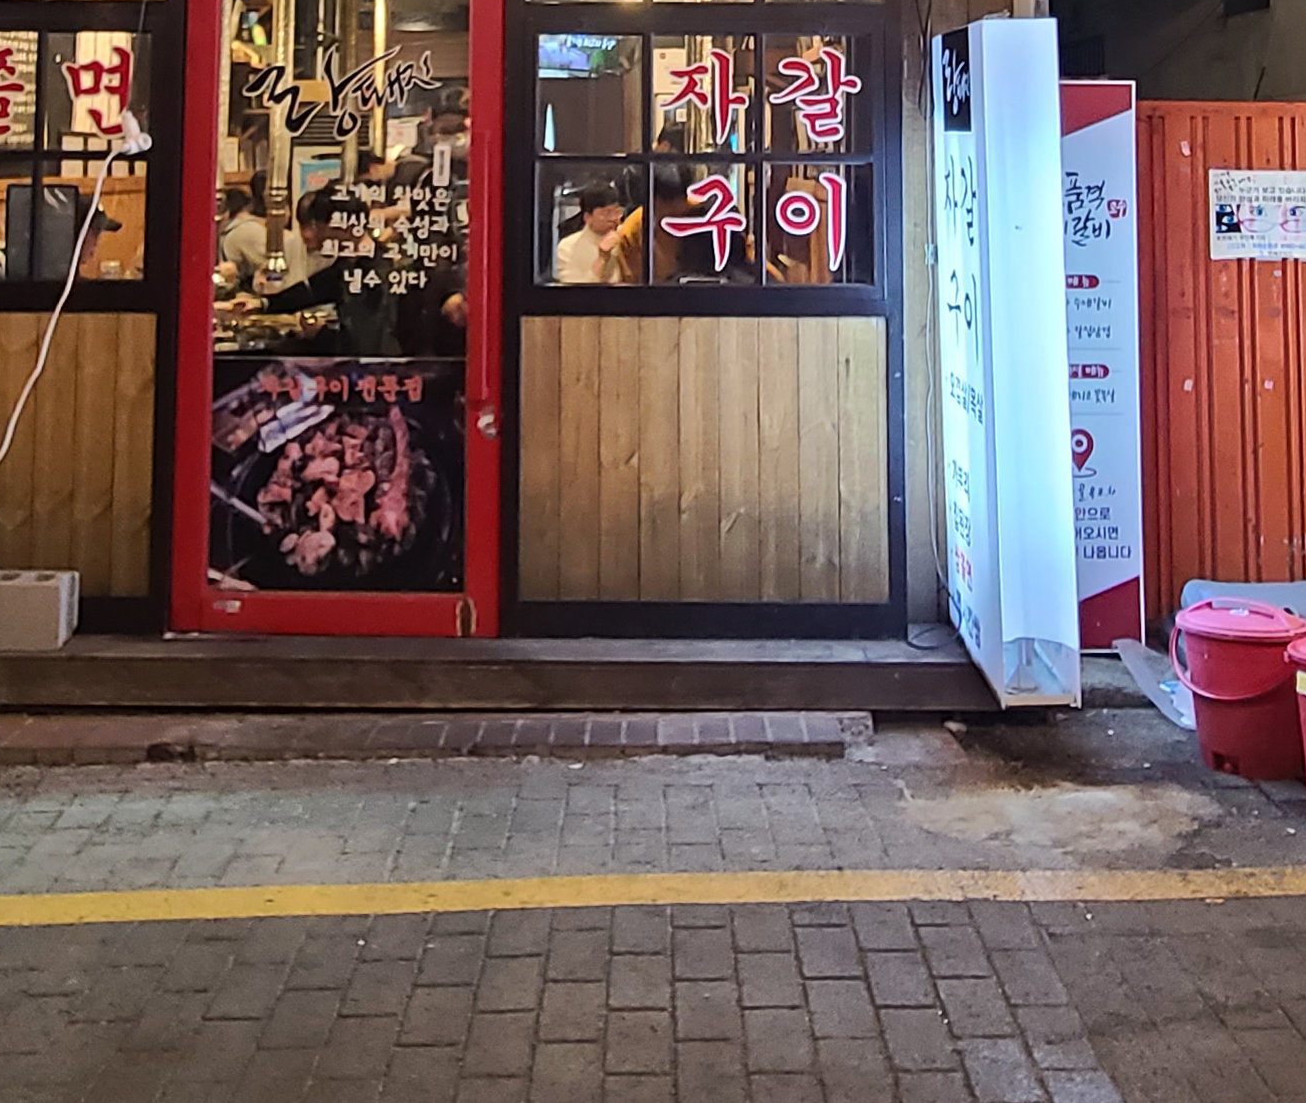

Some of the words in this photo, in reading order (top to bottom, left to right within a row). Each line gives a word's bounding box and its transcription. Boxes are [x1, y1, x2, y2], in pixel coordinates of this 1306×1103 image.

[659, 47, 862, 145] 자갈
[661, 172, 847, 272] 구이
[388, 270, 428, 294] 있다
